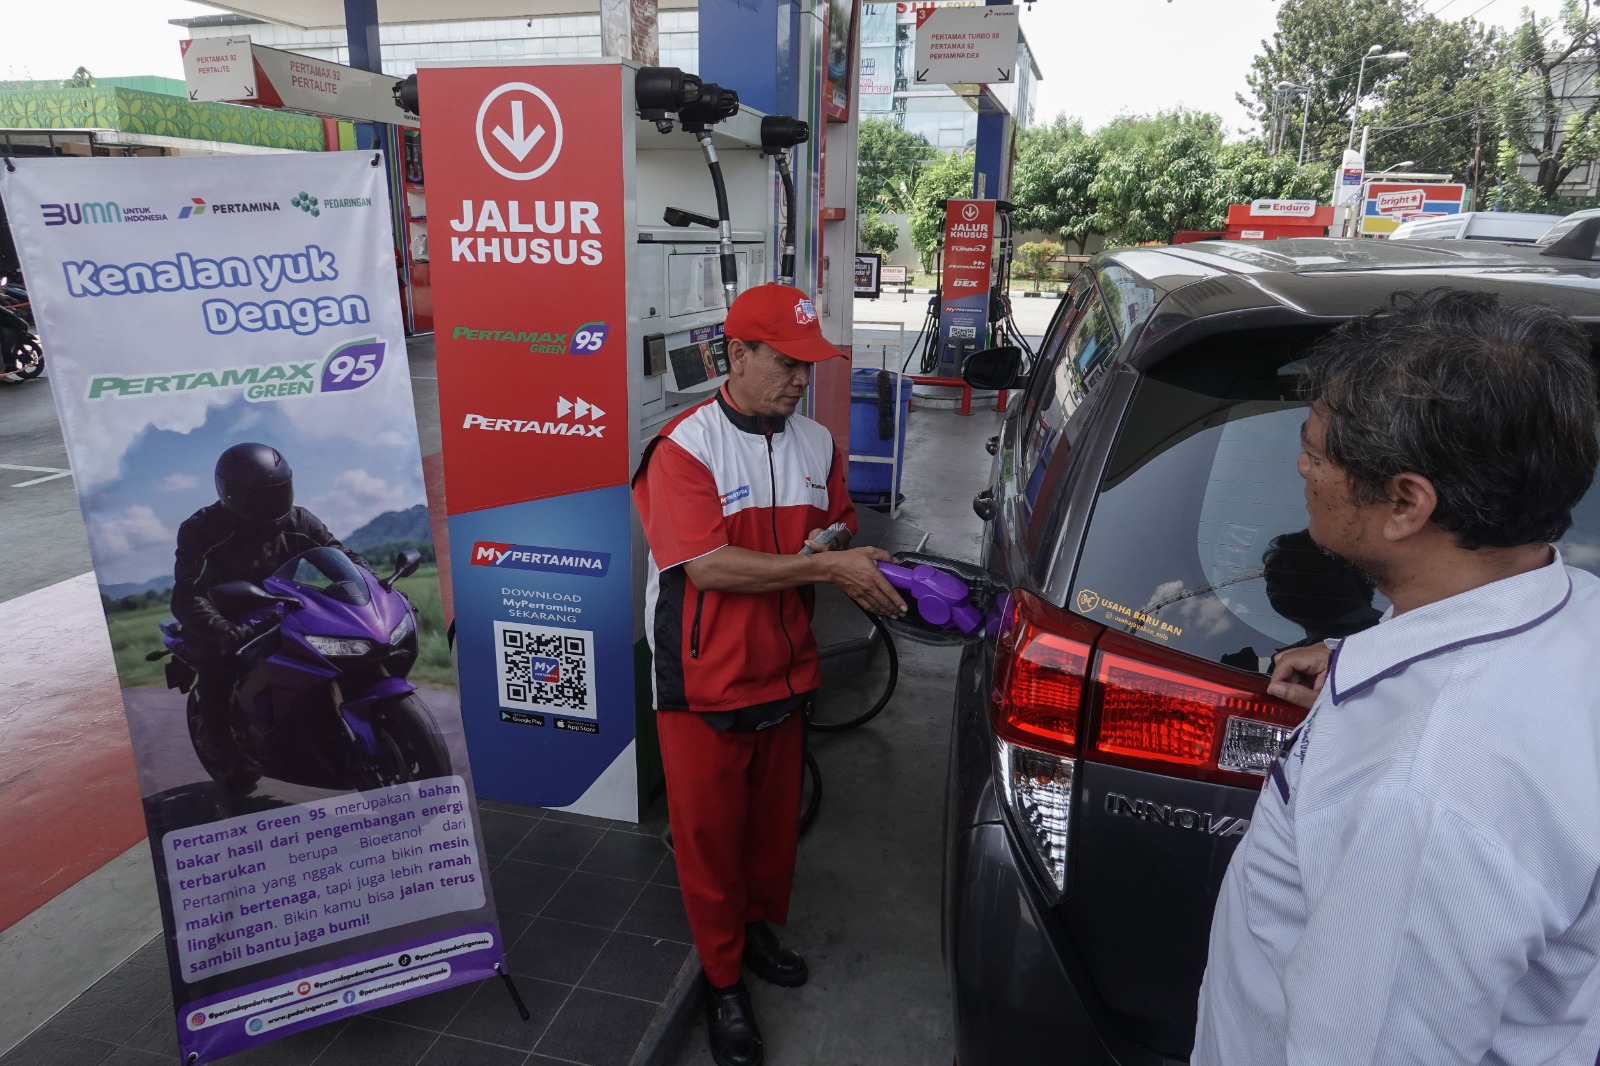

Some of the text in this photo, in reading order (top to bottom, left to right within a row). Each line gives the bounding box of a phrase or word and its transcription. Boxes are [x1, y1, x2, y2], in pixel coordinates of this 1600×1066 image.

[919, 10, 925, 19] 3
[197, 55, 229, 63] PERTAMAX
[198, 66, 230, 74] PERTALITE
[290, 61, 341, 80] PERTAMAX 92
[292, 76, 337, 94] PERTALITE
[212, 202, 280, 214] PERTAMINA
[324, 198, 371, 208] PEDARINGAN
[1381, 196, 1409, 205] bright
[40, 202, 122, 226] BUMN
[125, 214, 168, 222] INDONESIA
[450, 200, 601, 234] JALUR
[451, 237, 602, 265] KHUSUS
[62, 245, 338, 298] Kenalan yuk
[202, 294, 370, 335] Dengan
[452, 326, 603, 351] PERTAMAX 95
[530, 344, 566, 354] GREEN
[88, 355, 376, 399] PERTAMAX 95
[248, 381, 314, 399] GREEN
[463, 414, 606, 437] PERTAMAX
[501, 588, 582, 602] DOWNLOAD
[503, 598, 582, 613] MyPertamina
[509, 609, 576, 623] SEKARANG
[1101, 599, 1182, 636] USAHA BARU BAN
[173, 784, 460, 850] Pertamax Green 95 merupakan bahan
[1104, 792, 1250, 836] INNOVA
[176, 800, 463, 870] bakar hasil dari pengembangan energi
[179, 819, 466, 890] terbarukan berupa Bioetanol dari
[183, 837, 468, 910] Pertamina yang nggak cuma bikin mesin
[186, 855, 471, 931] makin bertenaga, tapi juga lebih ramah
[187, 874, 475, 952] lingkungan. Bikin kamu bisa jalan terus
[190, 914, 370, 973] sambil bantu jaga bumi!
[268, 999, 338, 1024] www.pedaringan.com
